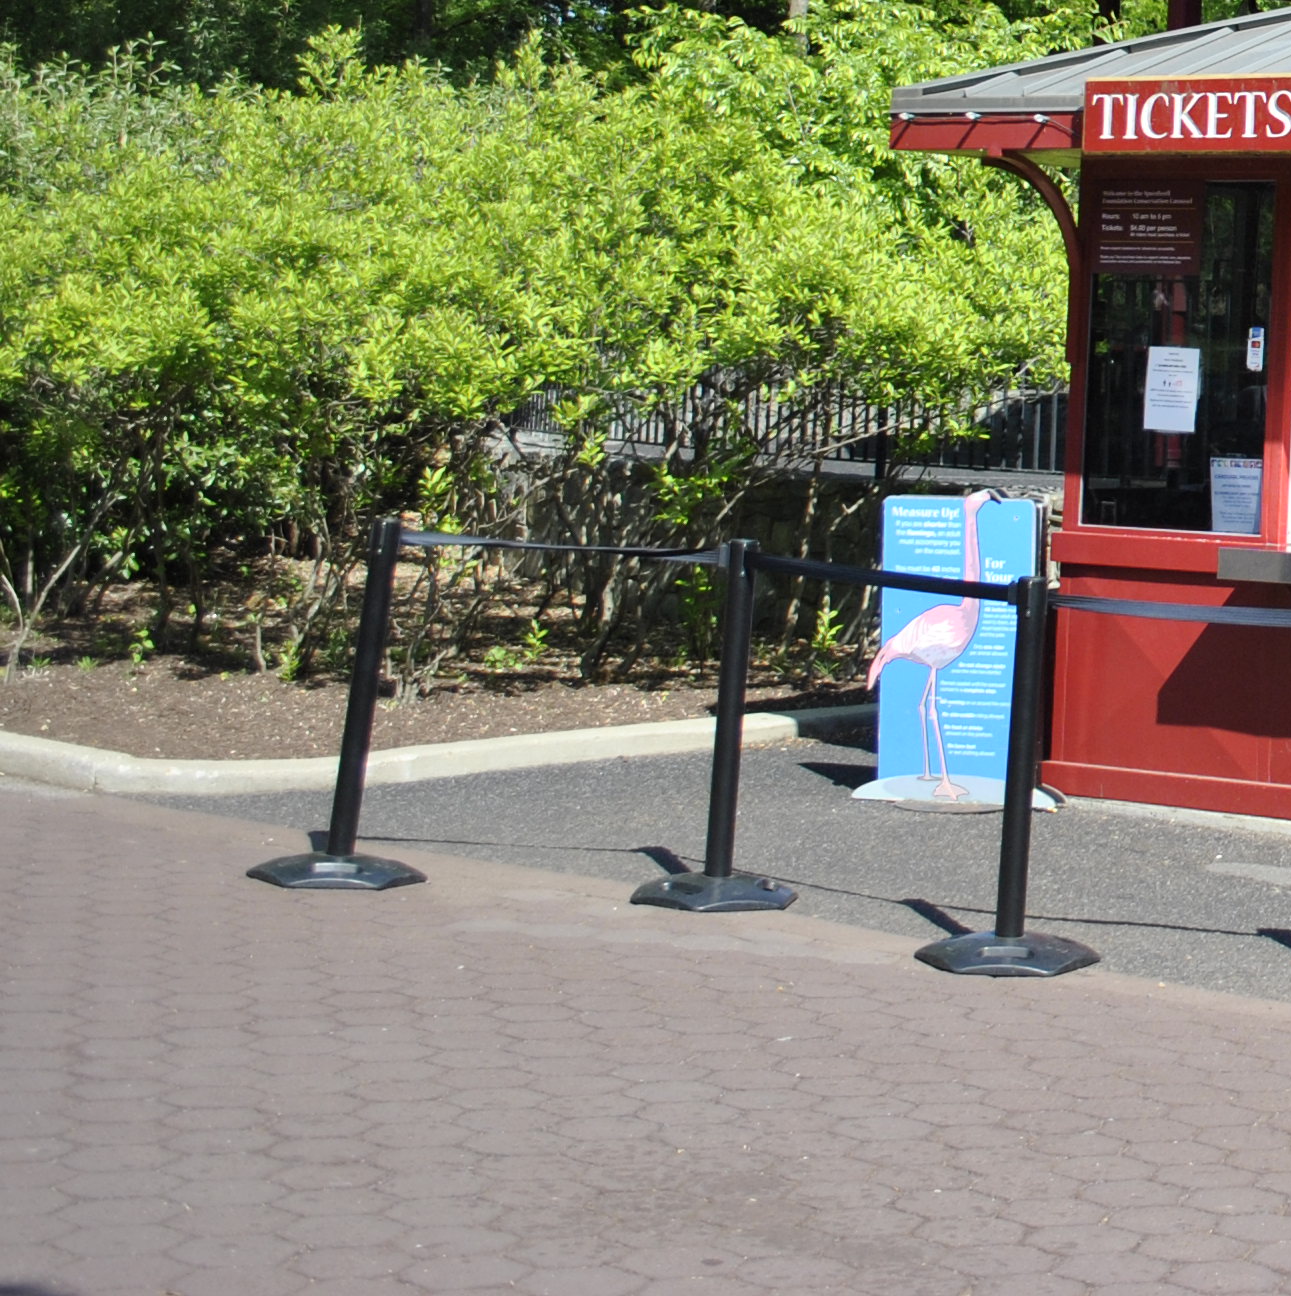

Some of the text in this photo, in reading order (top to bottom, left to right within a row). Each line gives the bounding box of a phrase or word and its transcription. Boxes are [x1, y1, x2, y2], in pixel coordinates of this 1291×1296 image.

[892, 506, 960, 520] Measure Up!
[985, 557, 1006, 569] For
[984, 571, 1014, 583] Your
